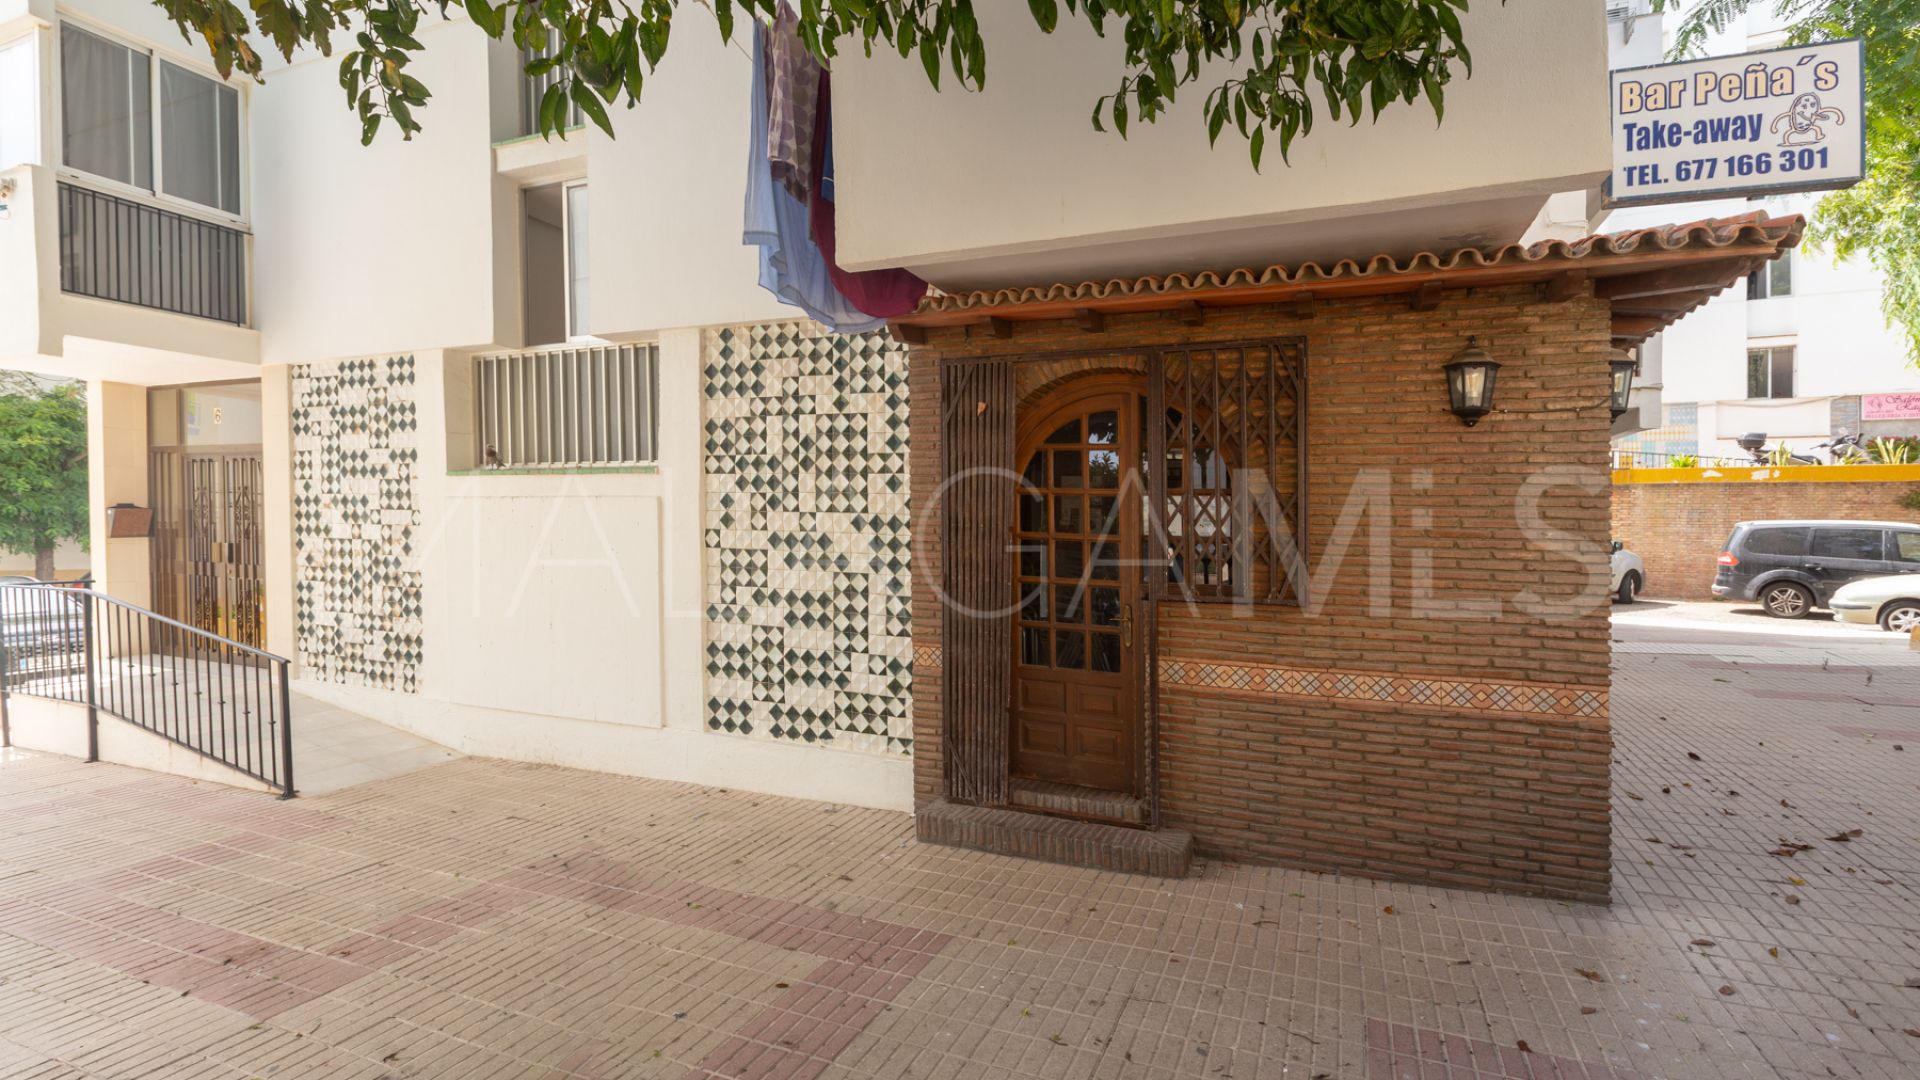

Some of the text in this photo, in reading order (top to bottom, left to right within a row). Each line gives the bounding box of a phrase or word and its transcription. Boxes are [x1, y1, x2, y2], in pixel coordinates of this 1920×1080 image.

[1619, 79, 1687, 115] Bar
[1622, 113, 1763, 152] Take-away
[1623, 146, 1829, 187] TEL. 677 166 301
[213, 407, 222, 425] 6
